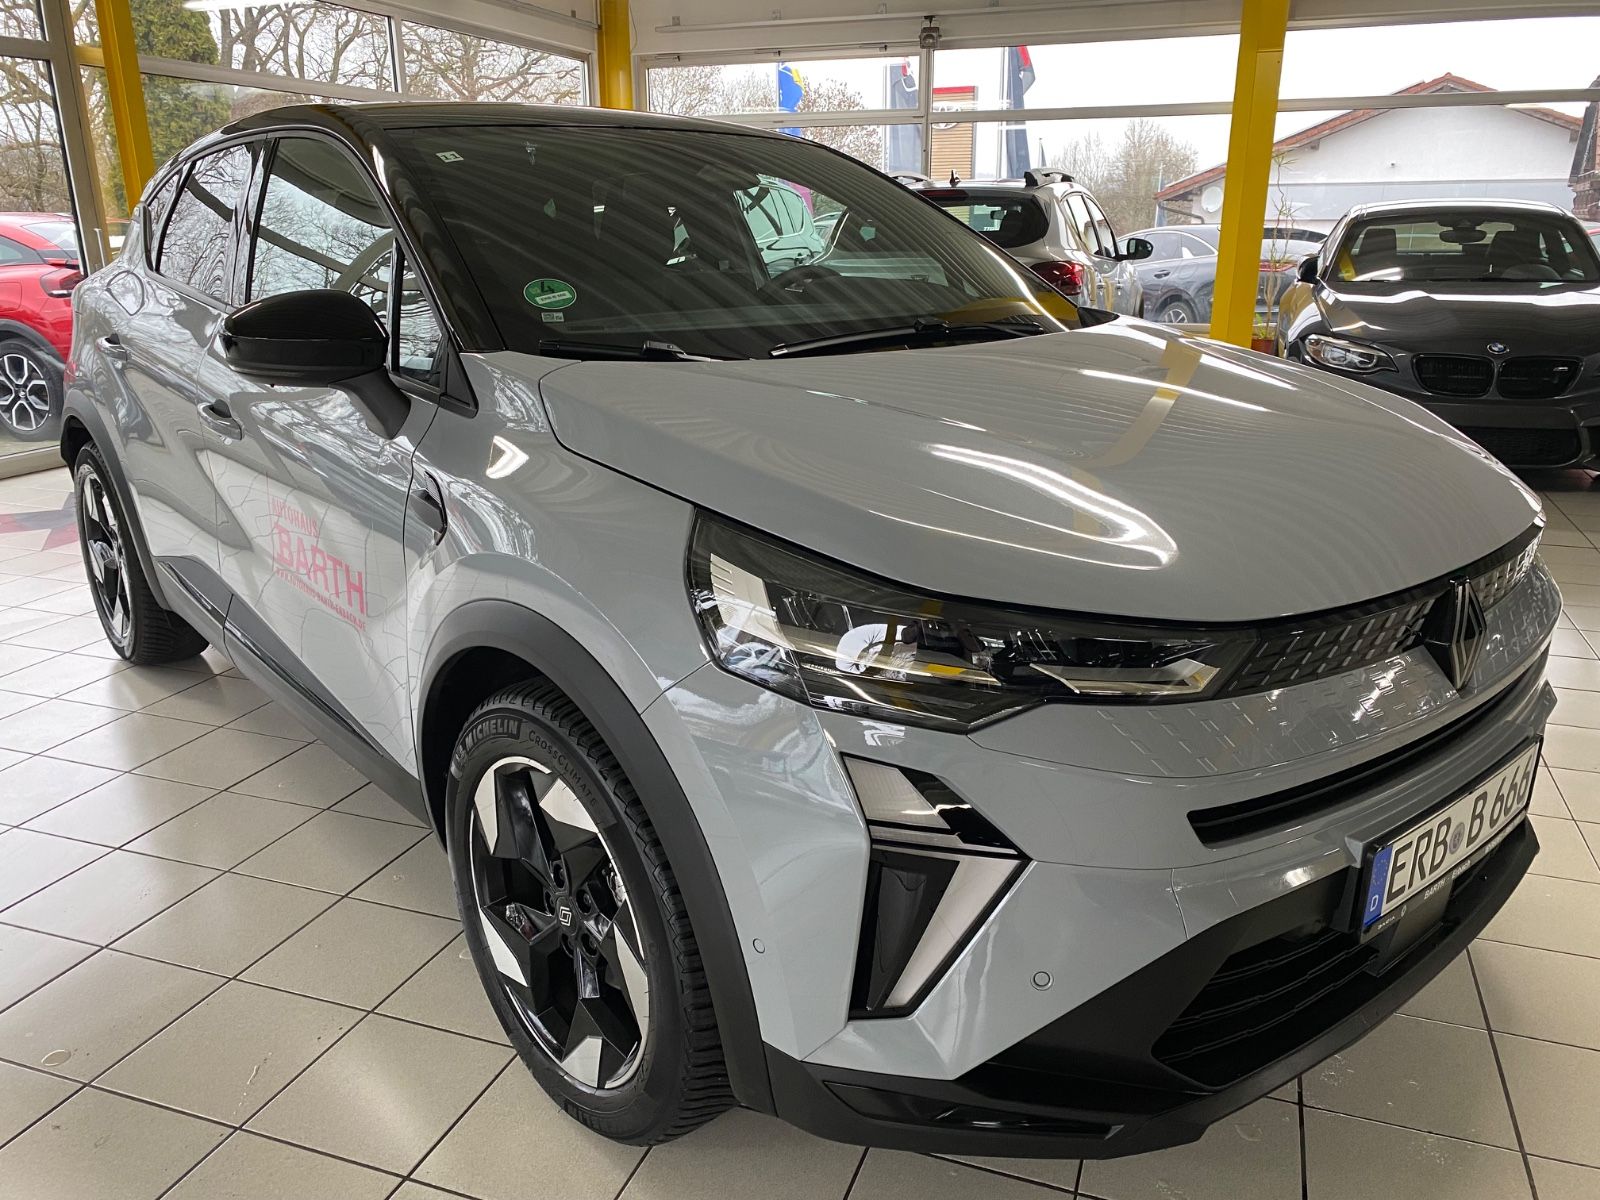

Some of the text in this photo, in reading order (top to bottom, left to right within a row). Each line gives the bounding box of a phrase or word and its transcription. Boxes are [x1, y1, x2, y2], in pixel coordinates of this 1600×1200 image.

[274, 522, 365, 617] BARTH
[464, 719, 519, 752] MICHELIN
[528, 729, 598, 805] CROSSCLIMATE
[1386, 816, 1452, 905] ERB
[1466, 791, 1488, 849] B
[1489, 754, 1533, 829] 666
[1370, 894, 1378, 912] D
